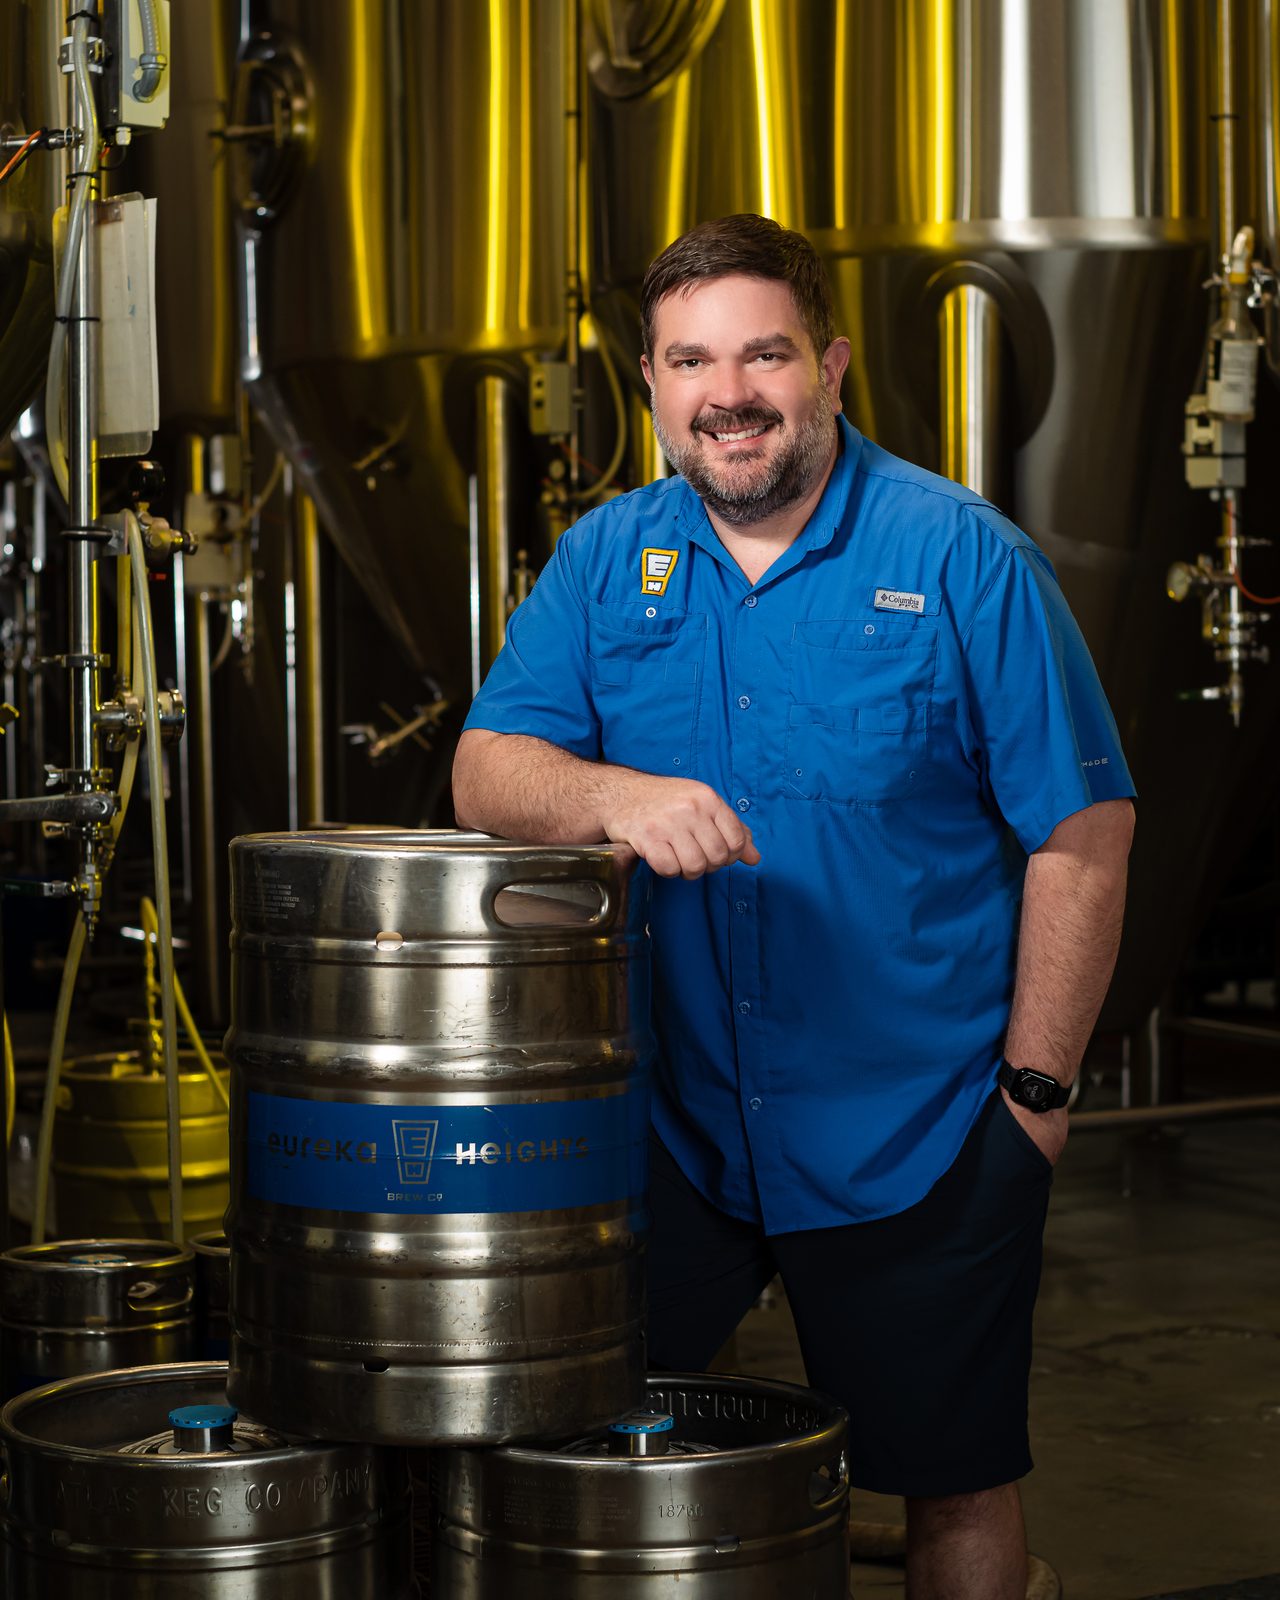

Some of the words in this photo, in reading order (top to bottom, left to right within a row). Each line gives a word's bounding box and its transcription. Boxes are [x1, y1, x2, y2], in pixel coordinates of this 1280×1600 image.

[889, 594, 919, 606] Columbia
[387, 1192, 422, 1201] BREW
[56, 1479, 140, 1513] ATLAS
[161, 1486, 223, 1518] KEG
[244, 1461, 372, 1513] COMPANY
